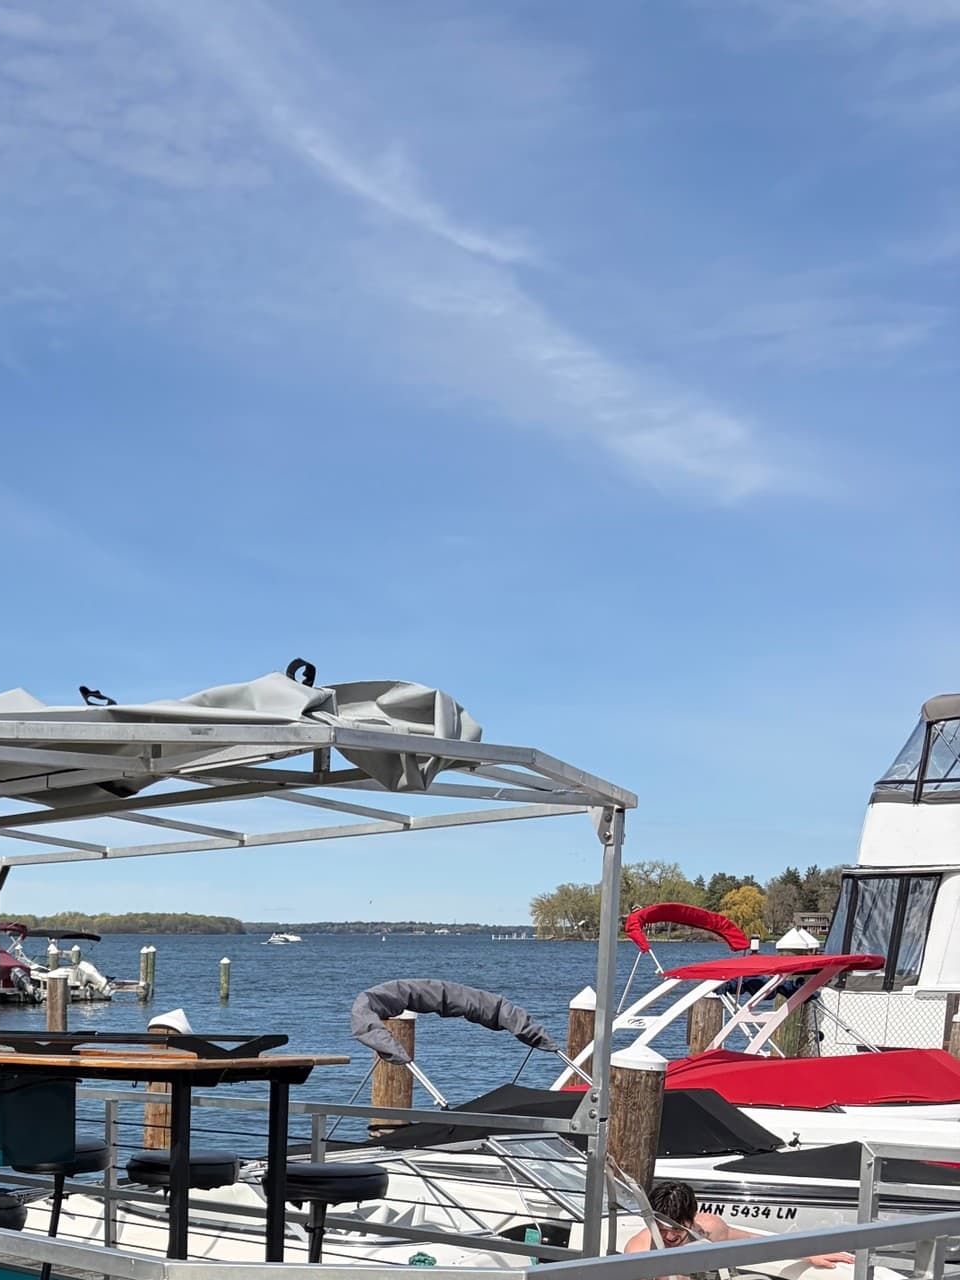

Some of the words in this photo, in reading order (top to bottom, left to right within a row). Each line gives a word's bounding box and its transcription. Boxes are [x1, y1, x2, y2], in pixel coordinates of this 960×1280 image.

[699, 1203, 725, 1216] MN
[730, 1205, 771, 1219] 5434
[776, 1208, 797, 1219] LN
